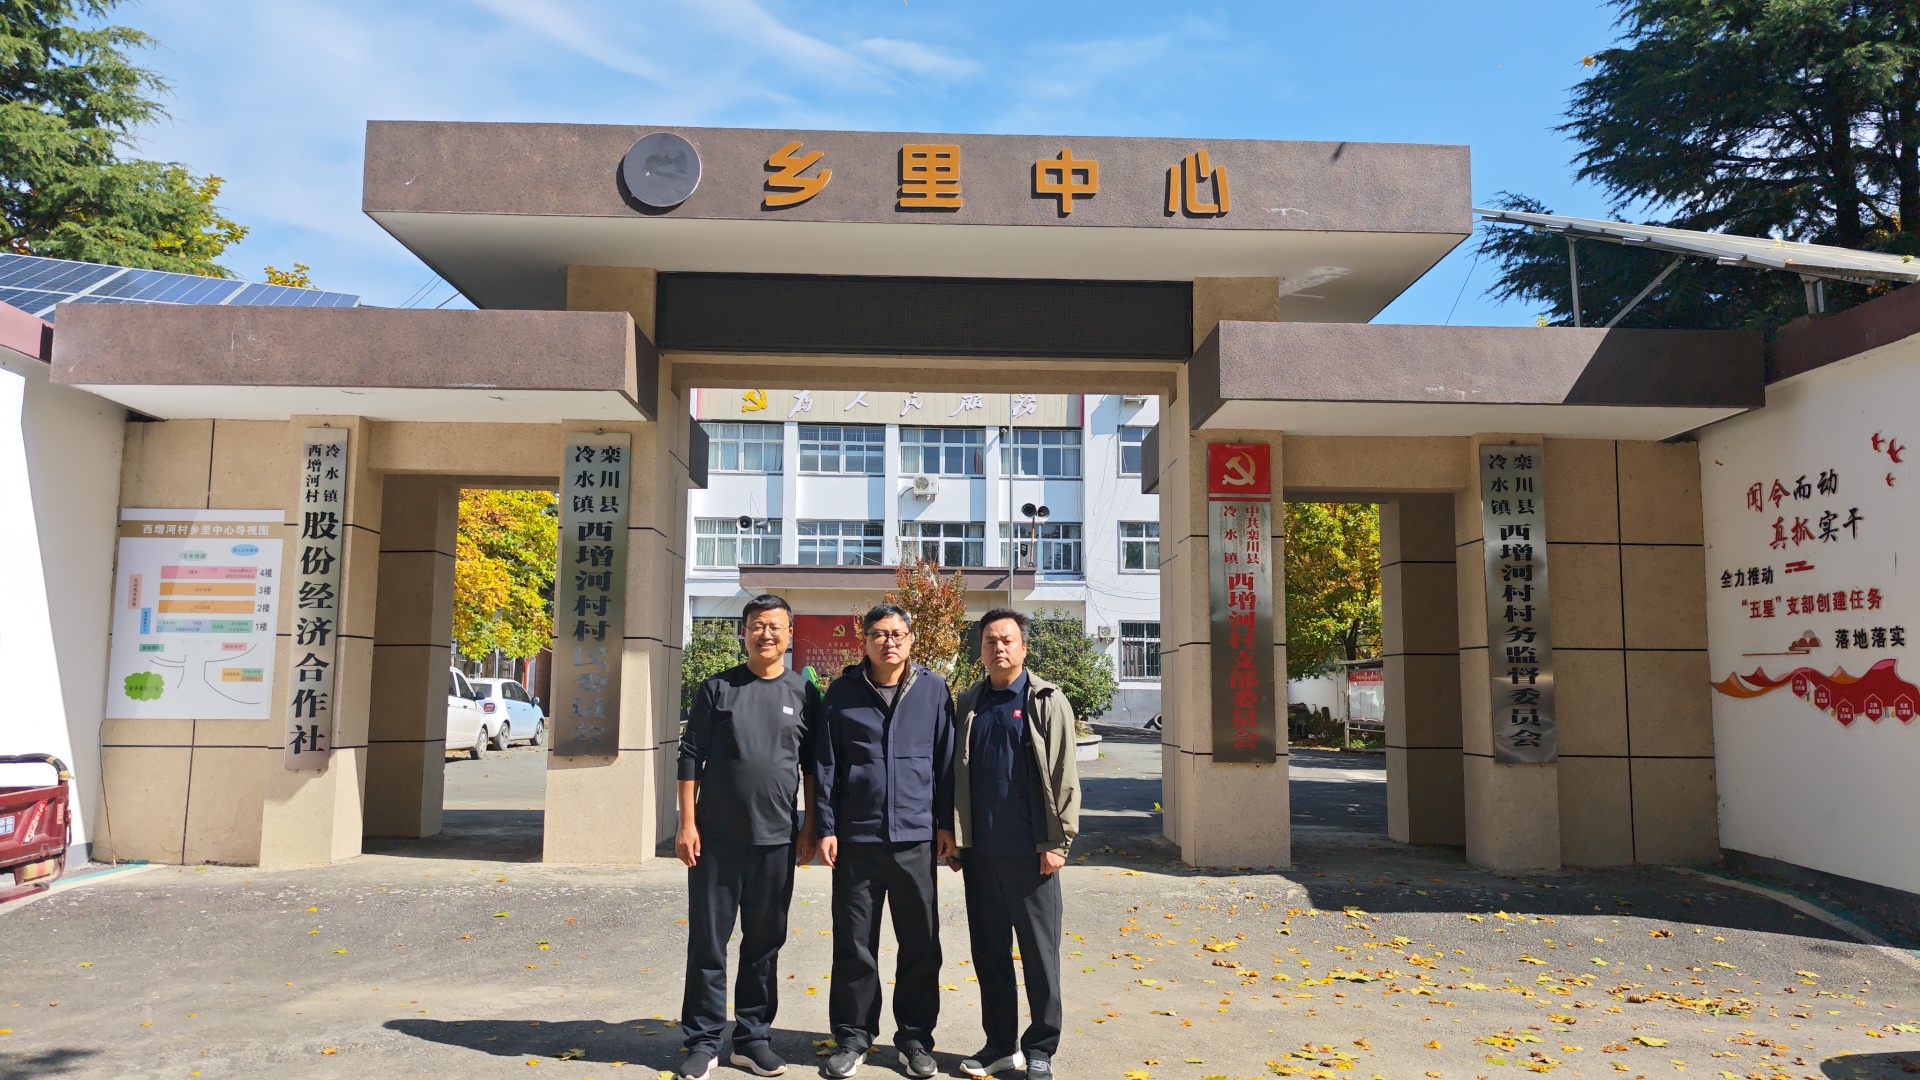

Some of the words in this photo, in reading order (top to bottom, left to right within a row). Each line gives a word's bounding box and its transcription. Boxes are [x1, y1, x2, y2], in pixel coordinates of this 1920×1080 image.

[763, 141, 1230, 214] 乡里中心
[305, 444, 322, 503] 西增河村
[323, 444, 340, 503] 冷水镇
[572, 445, 596, 514] 冷水镇
[599, 445, 621, 514] 栾川县
[1488, 454, 1512, 515] 冷水镇
[1512, 454, 1535, 515] 栾川县
[1747, 469, 1838, 513] 闻令而动
[142, 524, 269, 536] 西增河村乡里中心导视图
[1223, 505, 1238, 565] 冷水镇
[1245, 505, 1260, 565] 中共栾川县
[1769, 507, 1864, 550] 真抓实干
[258, 585, 272, 595] 3楼
[259, 568, 273, 578] 4楼
[1720, 566, 1774, 588] 全力推动
[255, 621, 268, 632] 1楼
[257, 604, 271, 613] 2楼
[1741, 588, 1882, 618] “五星”支部创建任务
[288, 511, 339, 755] 股份经济合作社
[1227, 572, 1259, 750] 西增河村支部委员会
[1499, 523, 1543, 748] 西增河村村务监督委员会
[1835, 626, 1905, 649] 落地落实
